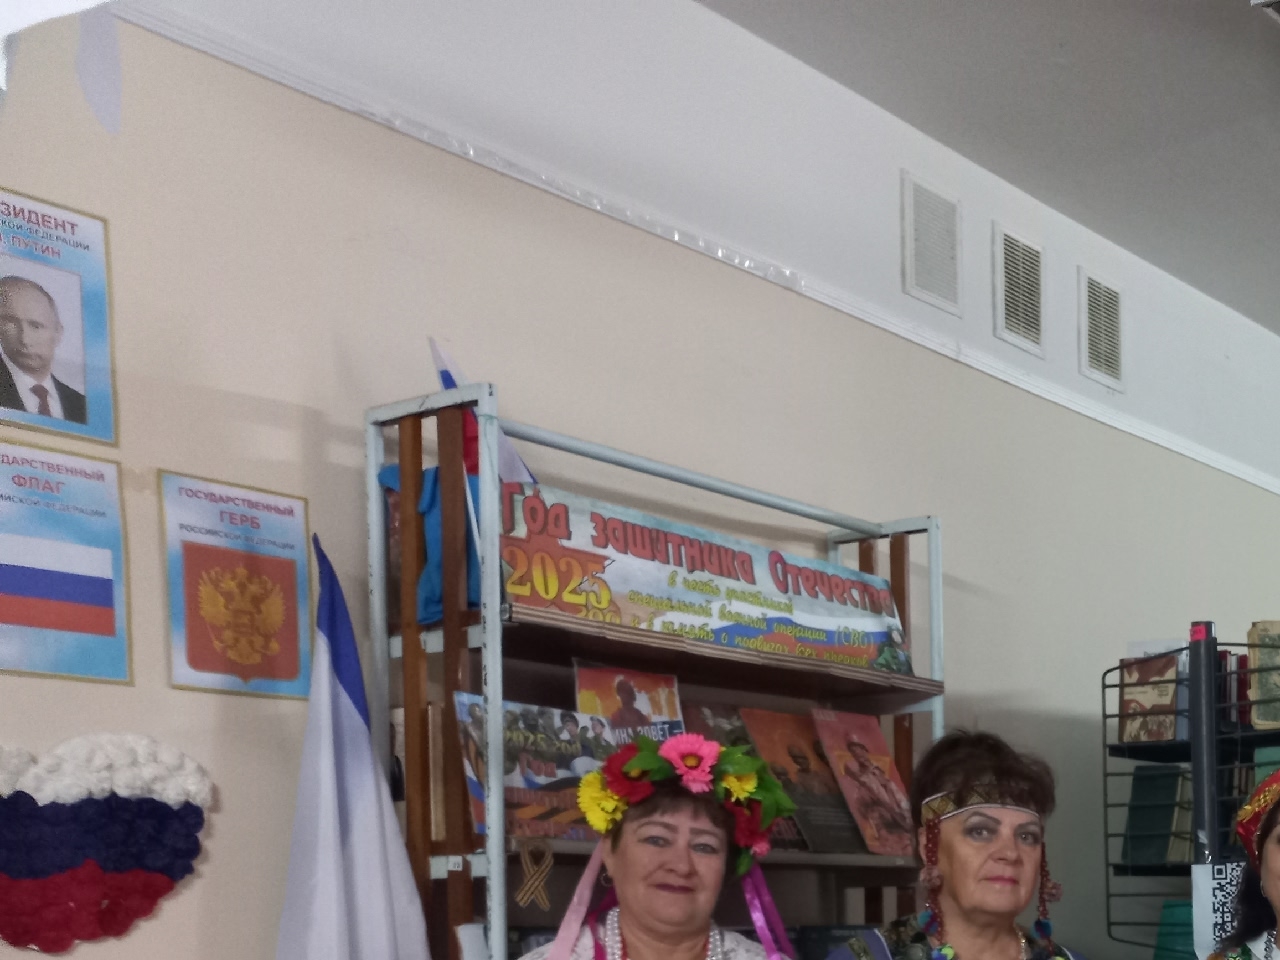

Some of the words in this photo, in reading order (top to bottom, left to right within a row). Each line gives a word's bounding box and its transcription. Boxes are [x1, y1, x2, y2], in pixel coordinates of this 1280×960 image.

[11, 234, 61, 259] ПУТИН
[0, 454, 105, 482] ДАРСТВЕННЫЙ
[11, 473, 65, 495] ФЛАГ
[178, 486, 295, 517] ГОСУДАРСТВЕННЫЙ
[219, 510, 261, 530] ГЕРБ
[501, 482, 572, 540] Год
[590, 511, 756, 586] защитника
[768, 550, 897, 619] Отечества
[502, 545, 612, 610] 2025
